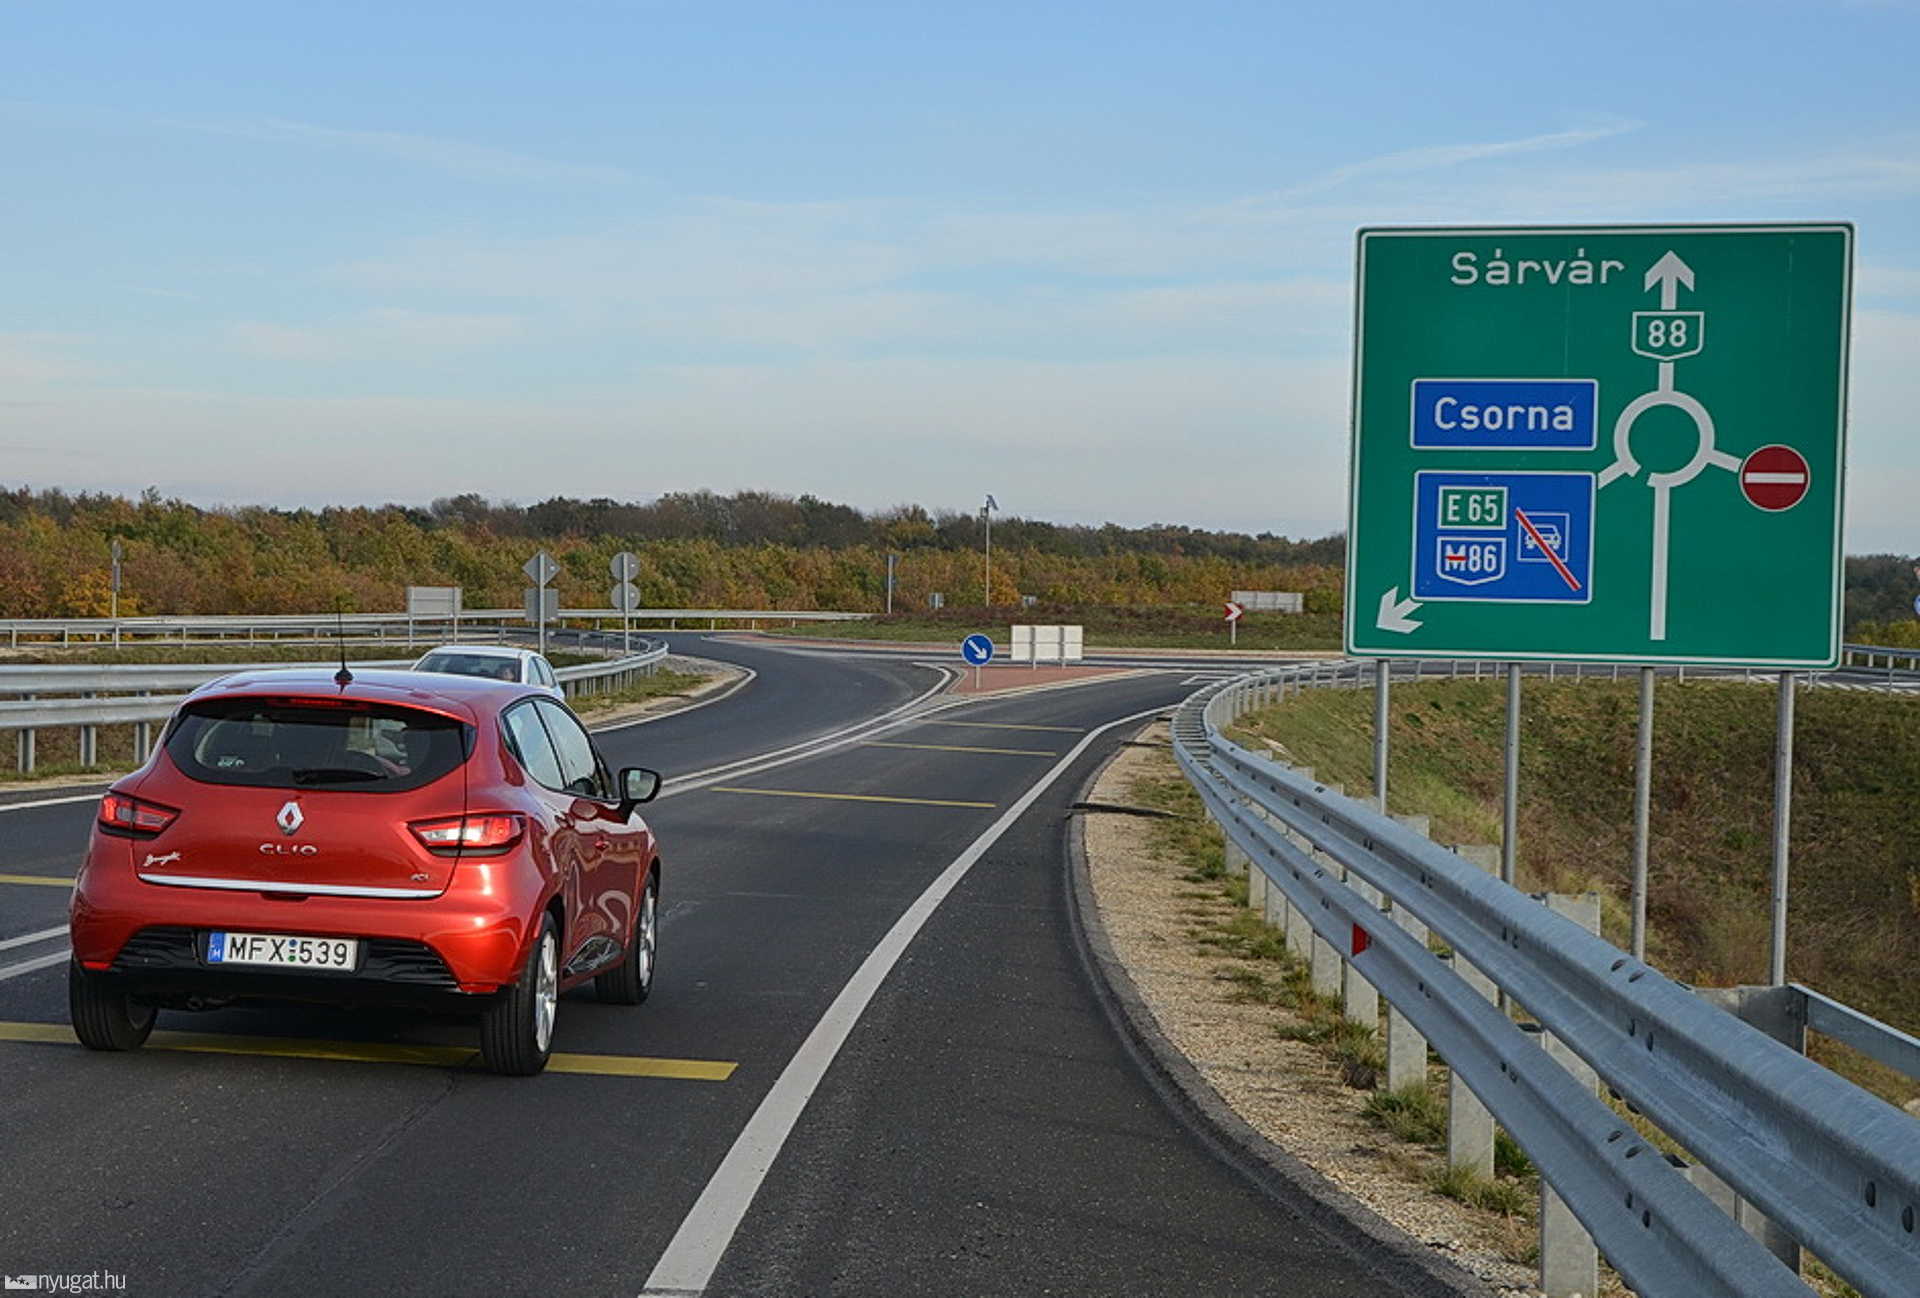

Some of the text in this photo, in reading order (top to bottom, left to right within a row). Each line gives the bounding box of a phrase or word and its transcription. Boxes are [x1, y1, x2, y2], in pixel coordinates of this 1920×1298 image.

[1450, 248, 1625, 285] Sárvár
[1648, 319, 1687, 348] 88
[1434, 396, 1574, 431] Csorna
[1447, 494, 1498, 522] E 65
[1444, 543, 1497, 573] M86
[259, 843, 318, 856] CLIO
